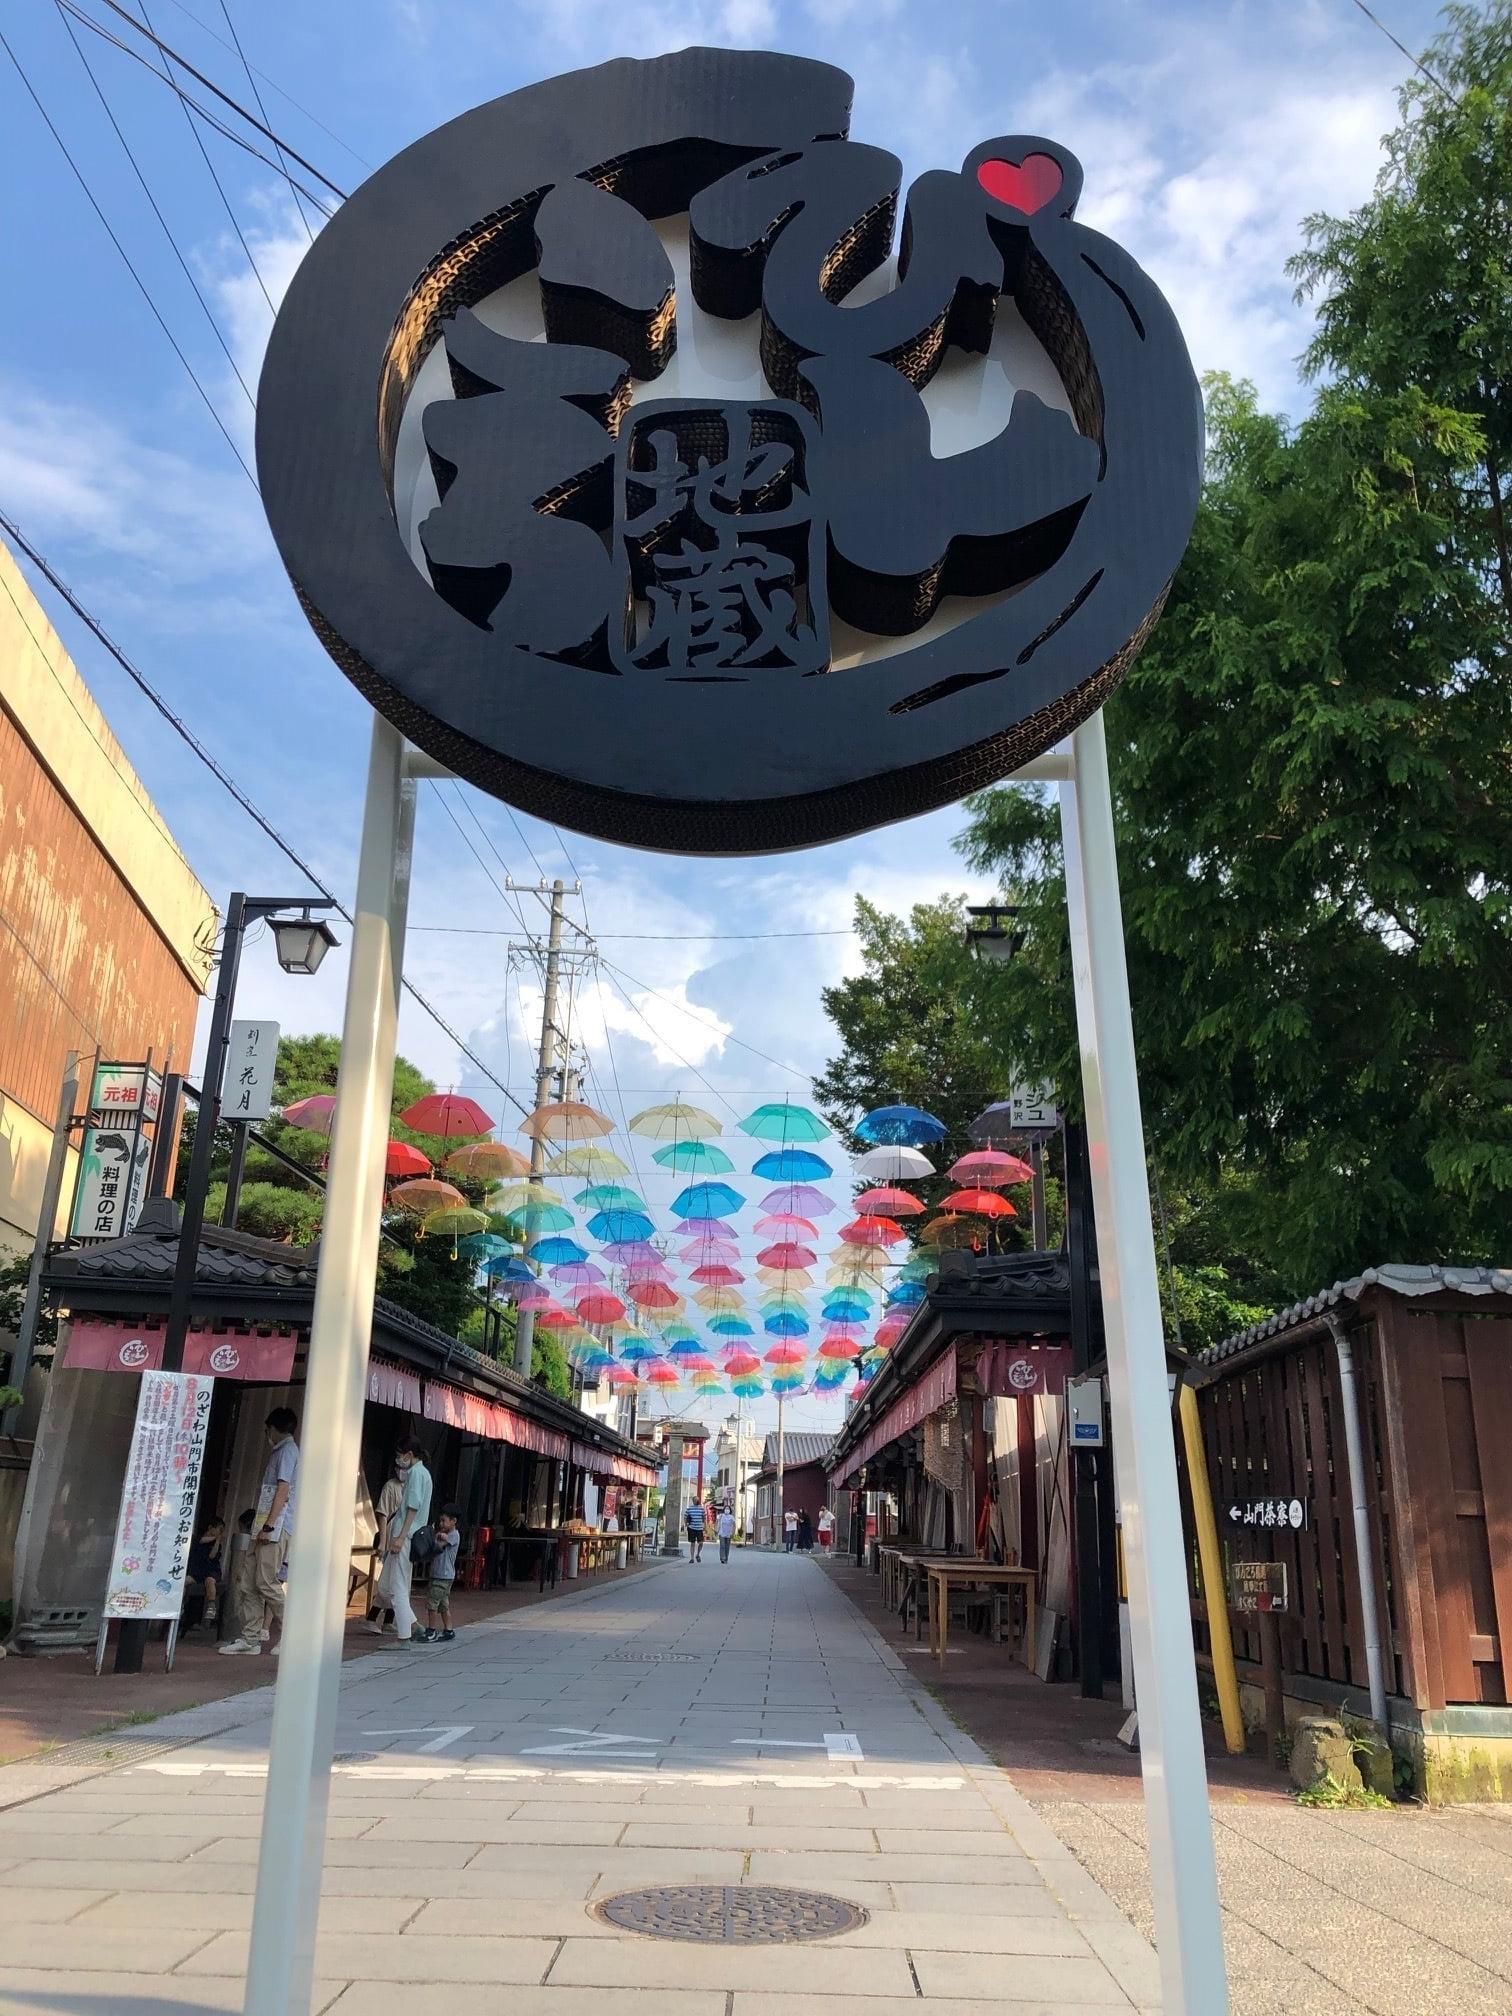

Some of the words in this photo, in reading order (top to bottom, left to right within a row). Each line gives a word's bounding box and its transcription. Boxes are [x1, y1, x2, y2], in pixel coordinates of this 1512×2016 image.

[103, 1086, 138, 1103] 元祖
[236, 1065, 259, 1111] 花月
[94, 1166, 120, 1232] 料理の店
[167, 1390, 210, 1580] のざわ山門市開催のお知らせ
